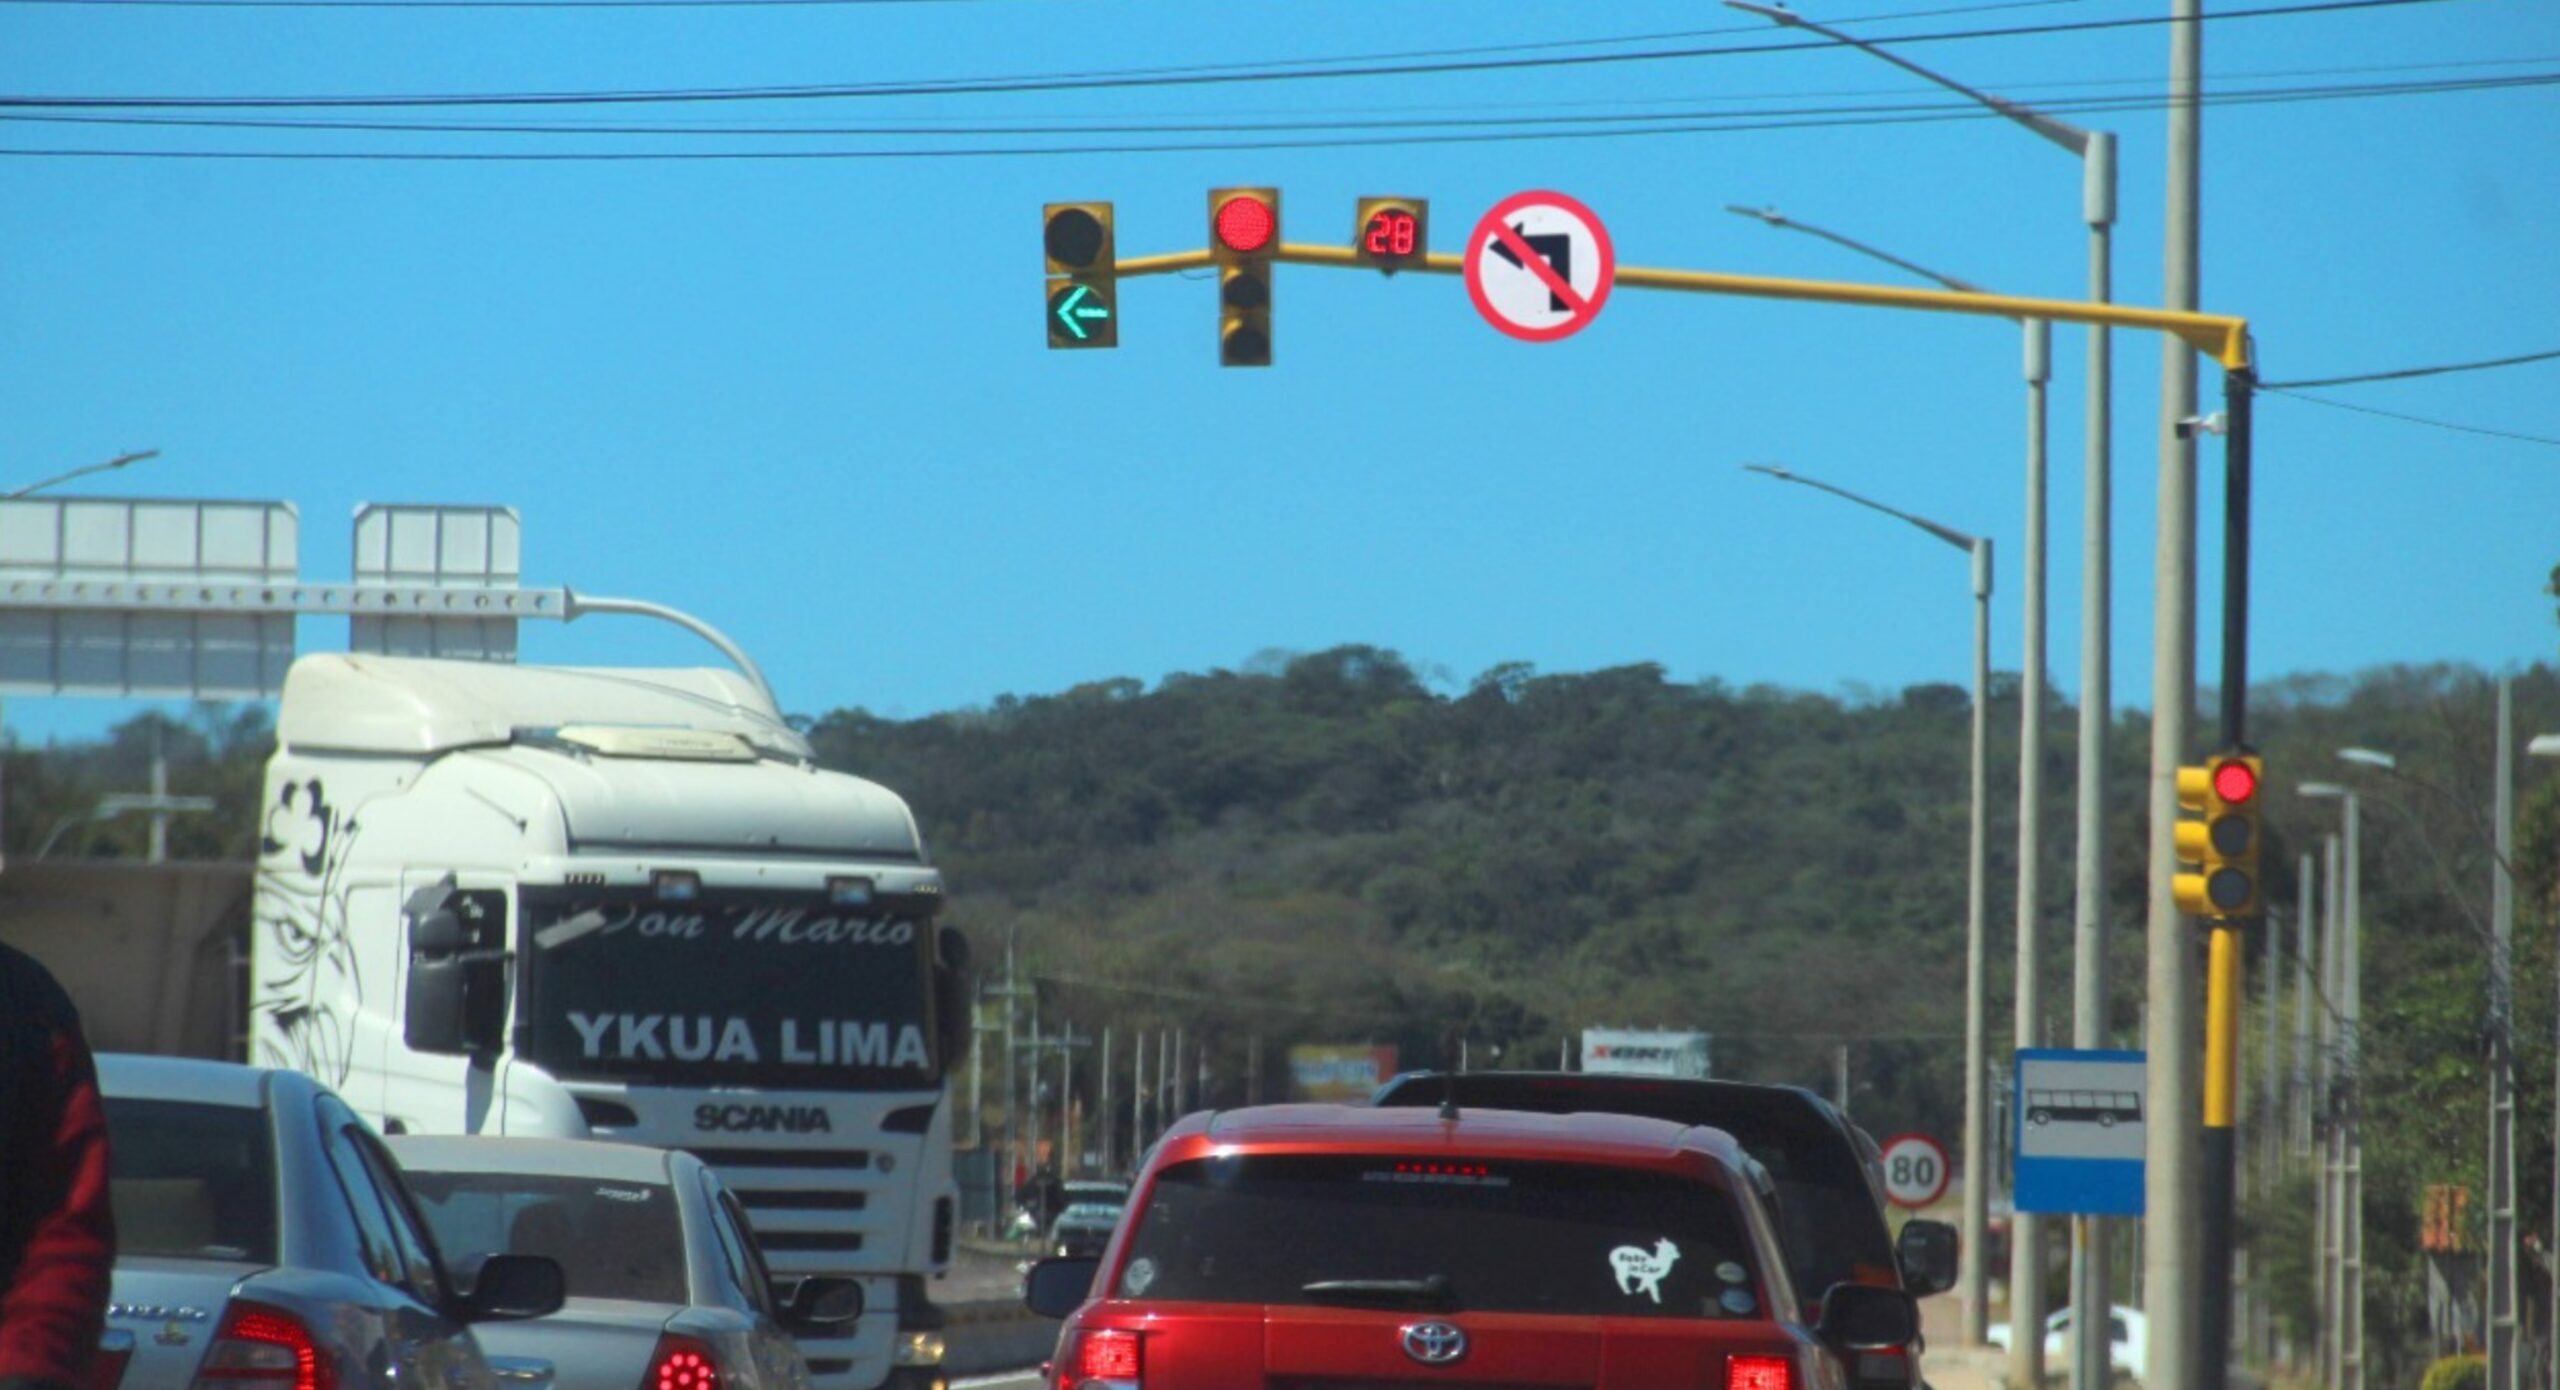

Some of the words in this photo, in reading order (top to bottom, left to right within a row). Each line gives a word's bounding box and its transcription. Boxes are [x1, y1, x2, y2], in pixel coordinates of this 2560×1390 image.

[1367, 212, 1414, 254] 28
[723, 905, 914, 946] Mario
[567, 1011, 759, 1063] YKUA
[780, 1018, 930, 1069] LIMA
[694, 1104, 832, 1134] SCANIA
[1892, 1155, 1935, 1187] 80
